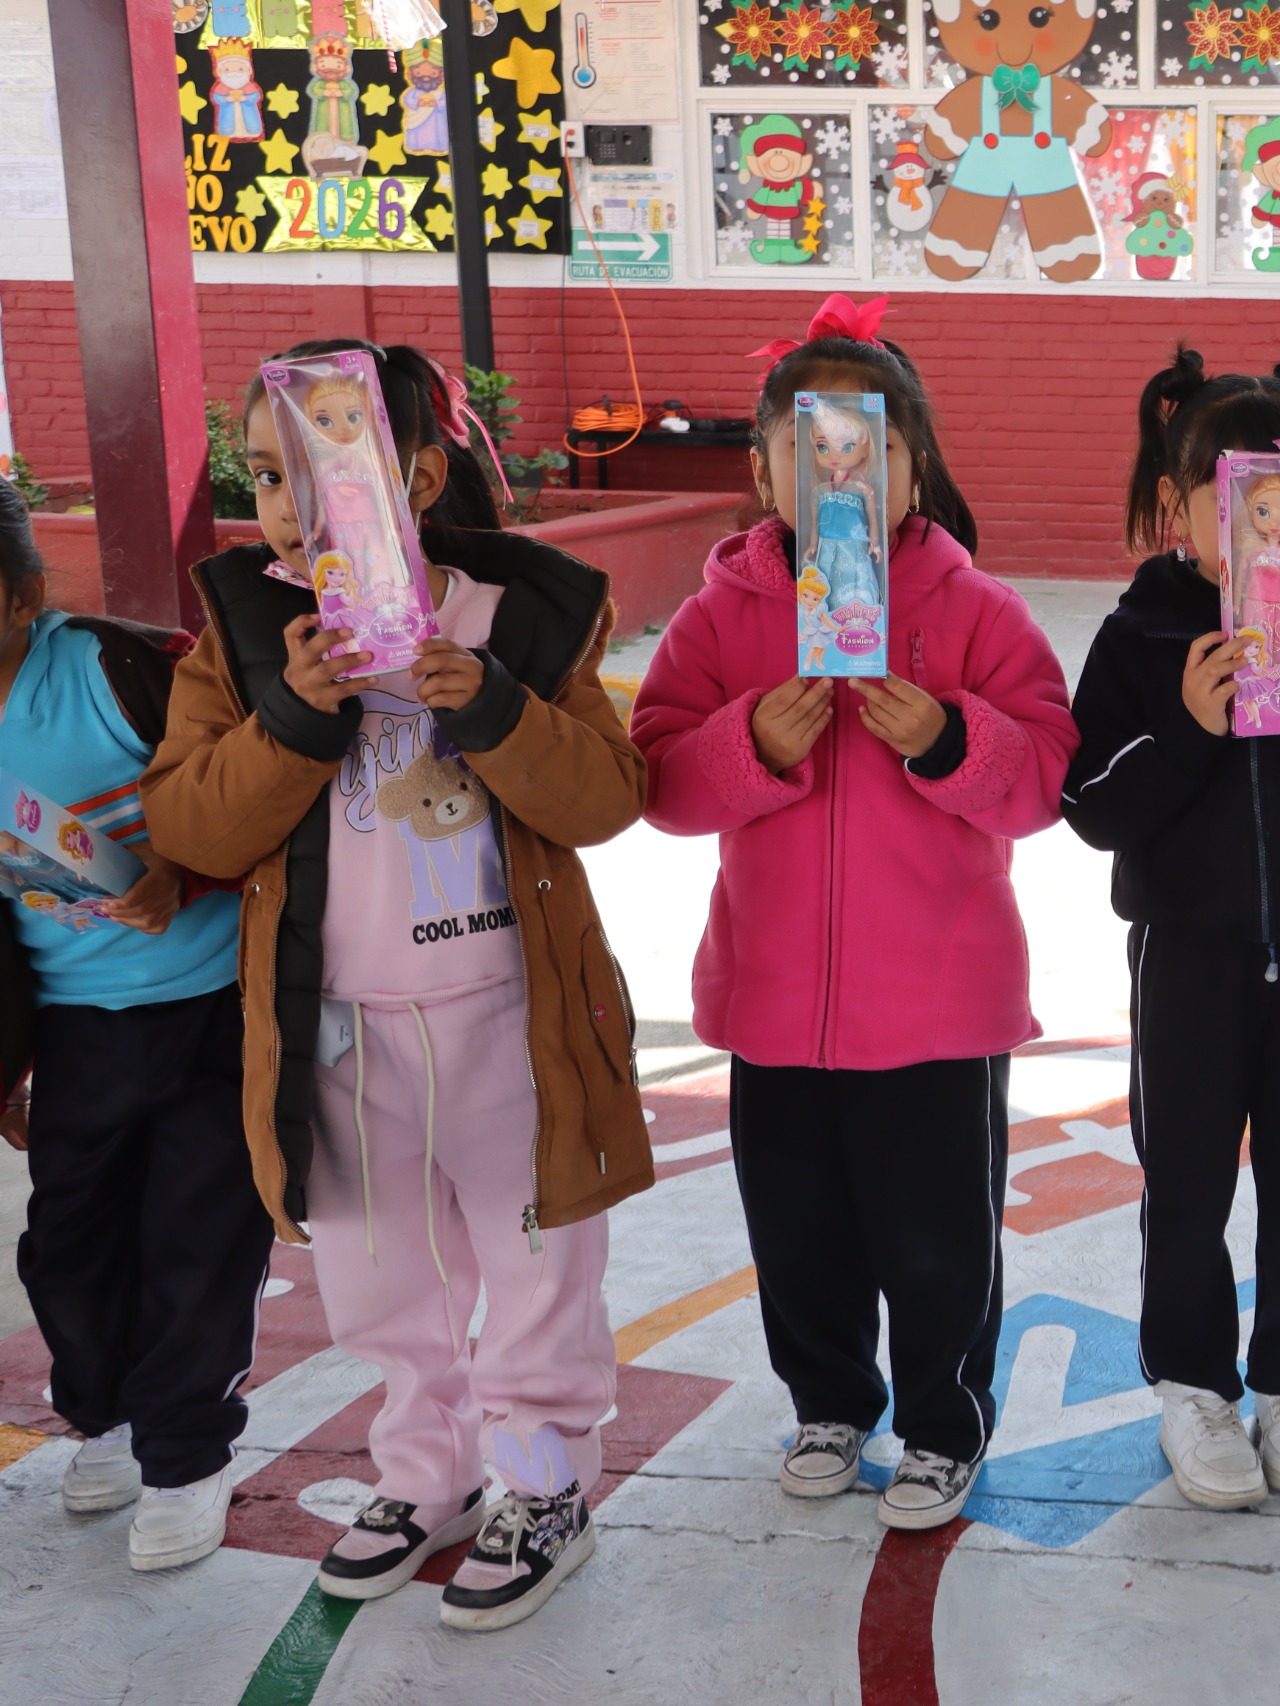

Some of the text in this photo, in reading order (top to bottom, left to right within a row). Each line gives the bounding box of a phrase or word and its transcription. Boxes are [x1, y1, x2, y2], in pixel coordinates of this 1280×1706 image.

[285, 178, 406, 239] 2026
[572, 265, 669, 277] RUTA DE EVACUACIÓN
[346, 356, 357, 364] 3+
[412, 920, 464, 945] COOL
